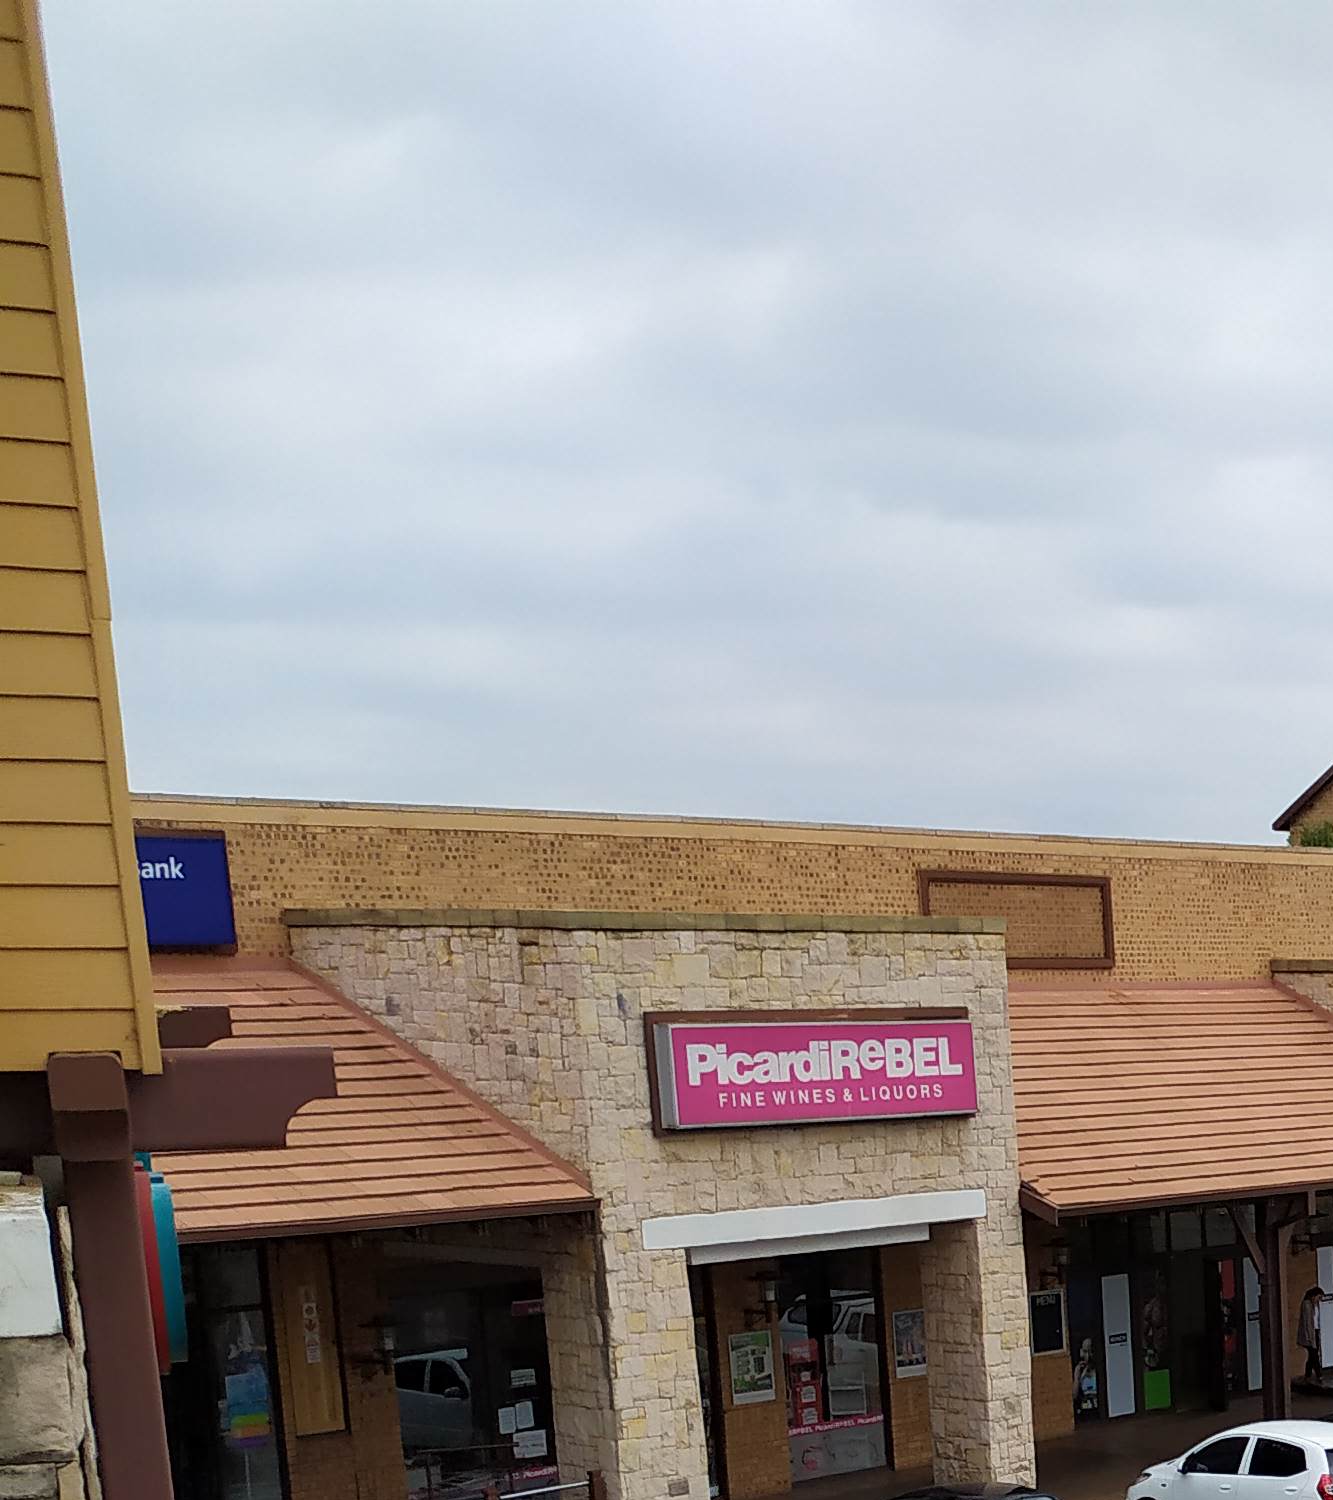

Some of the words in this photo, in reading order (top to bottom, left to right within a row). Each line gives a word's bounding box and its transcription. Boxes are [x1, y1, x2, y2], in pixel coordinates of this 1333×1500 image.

[138, 857, 184, 879] ank
[719, 1092, 766, 1109] FINE
[772, 1087, 836, 1105] WINES
[842, 1086, 854, 1103] &
[859, 1083, 944, 1102] LIQUORS
